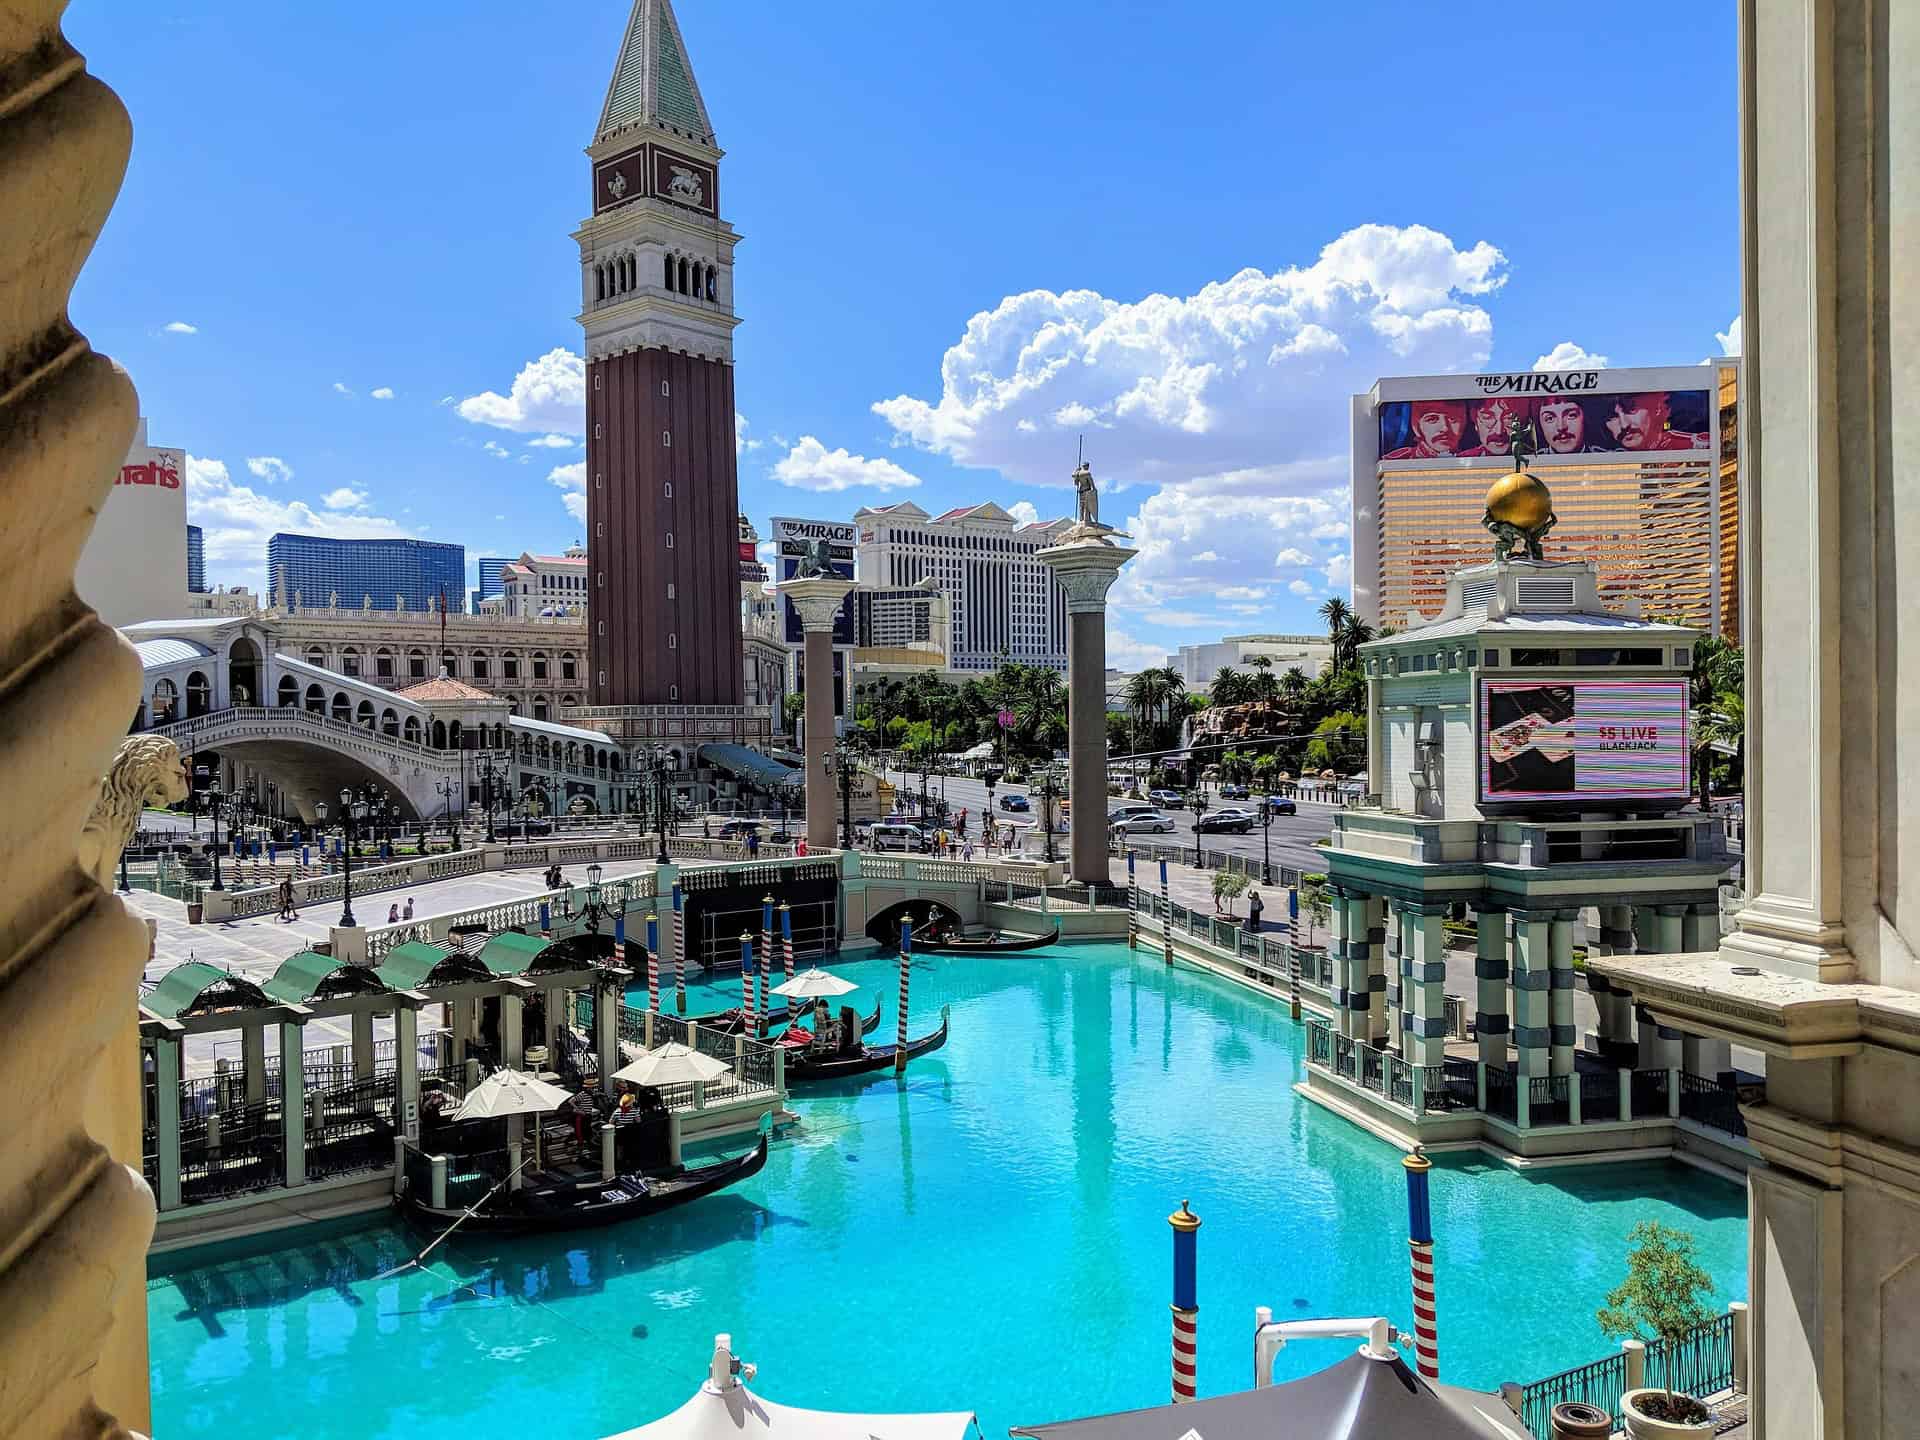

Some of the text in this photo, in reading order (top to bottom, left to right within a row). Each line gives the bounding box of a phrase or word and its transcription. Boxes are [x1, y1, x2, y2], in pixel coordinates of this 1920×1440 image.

[1475, 372, 1599, 394] THE MIRAGE
[780, 522, 797, 530] THE
[785, 524, 854, 541] MIRAGE
[1622, 727, 1658, 740] LIVE
[1599, 741, 1657, 751] BLACKJACK
